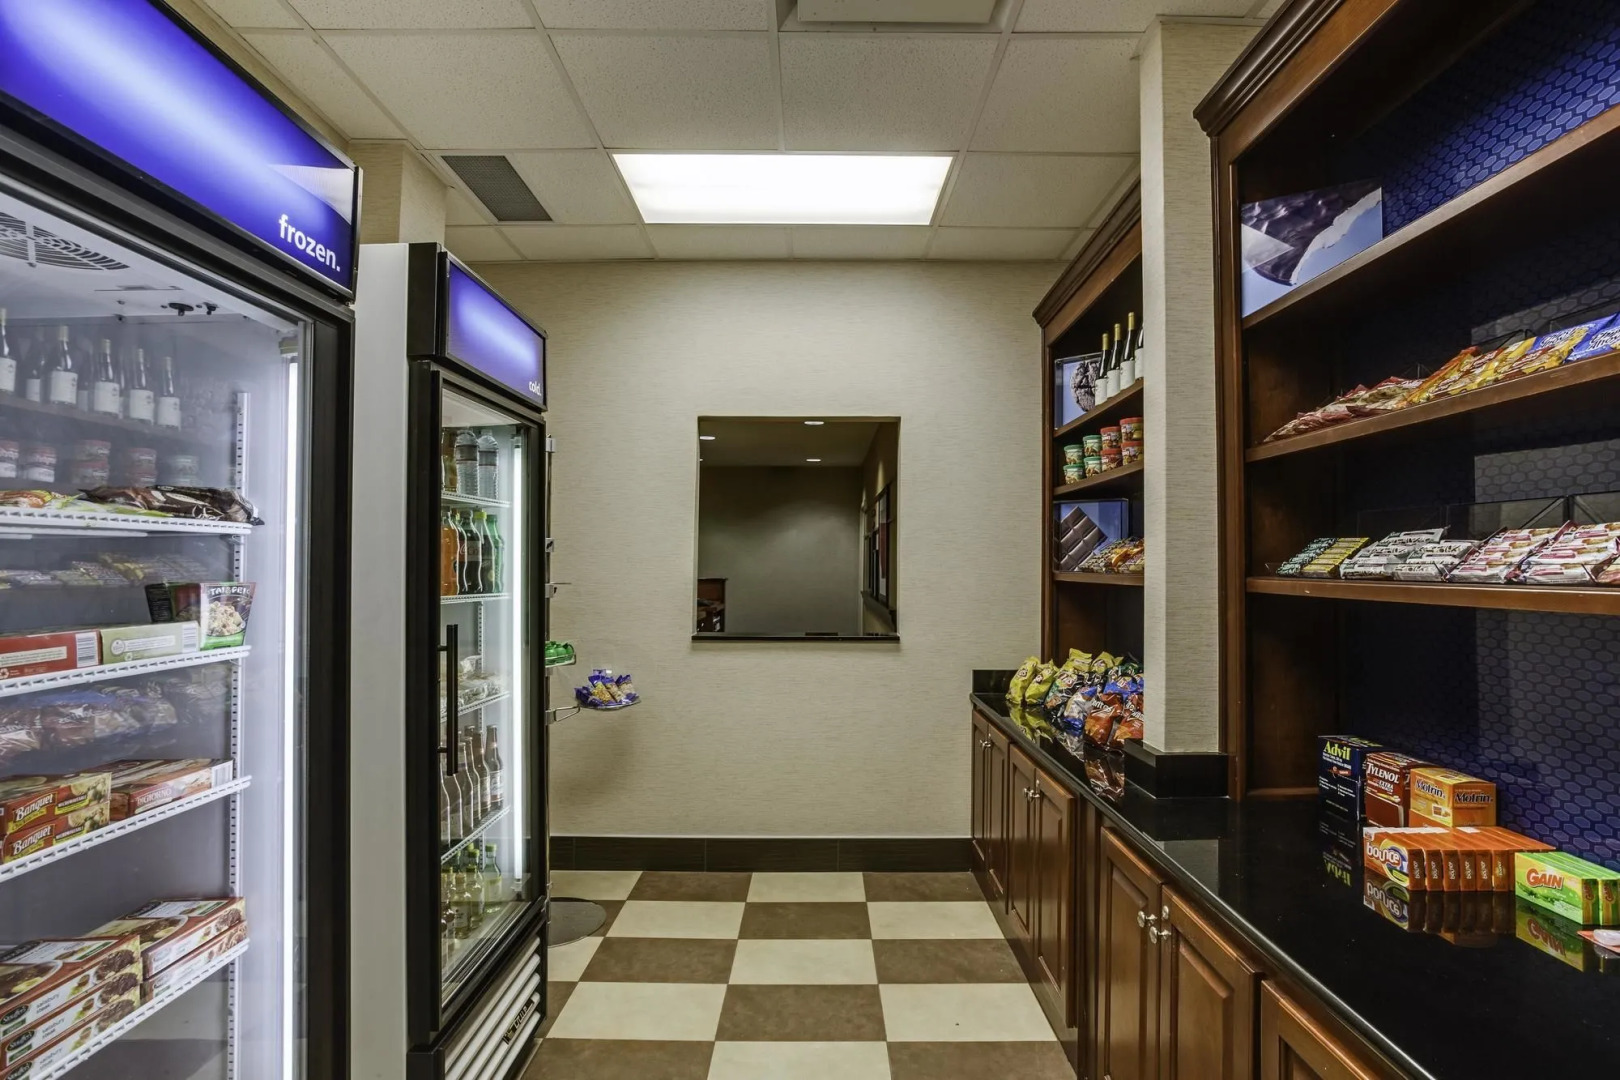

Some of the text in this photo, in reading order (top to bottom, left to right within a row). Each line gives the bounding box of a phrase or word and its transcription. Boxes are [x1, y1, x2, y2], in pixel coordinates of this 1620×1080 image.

[279, 213, 341, 272] frozen.
[529, 380, 542, 396] cold.
[1323, 740, 1351, 761] Advil
[1366, 761, 1401, 784] TYLENOL
[1415, 778, 1444, 798] Motrin
[1454, 791, 1491, 804] Motrin
[15, 792, 54, 822] Banquet
[13, 825, 52, 855] Banquet
[1366, 841, 1400, 867] bounce
[1526, 868, 1564, 890] GAIN
